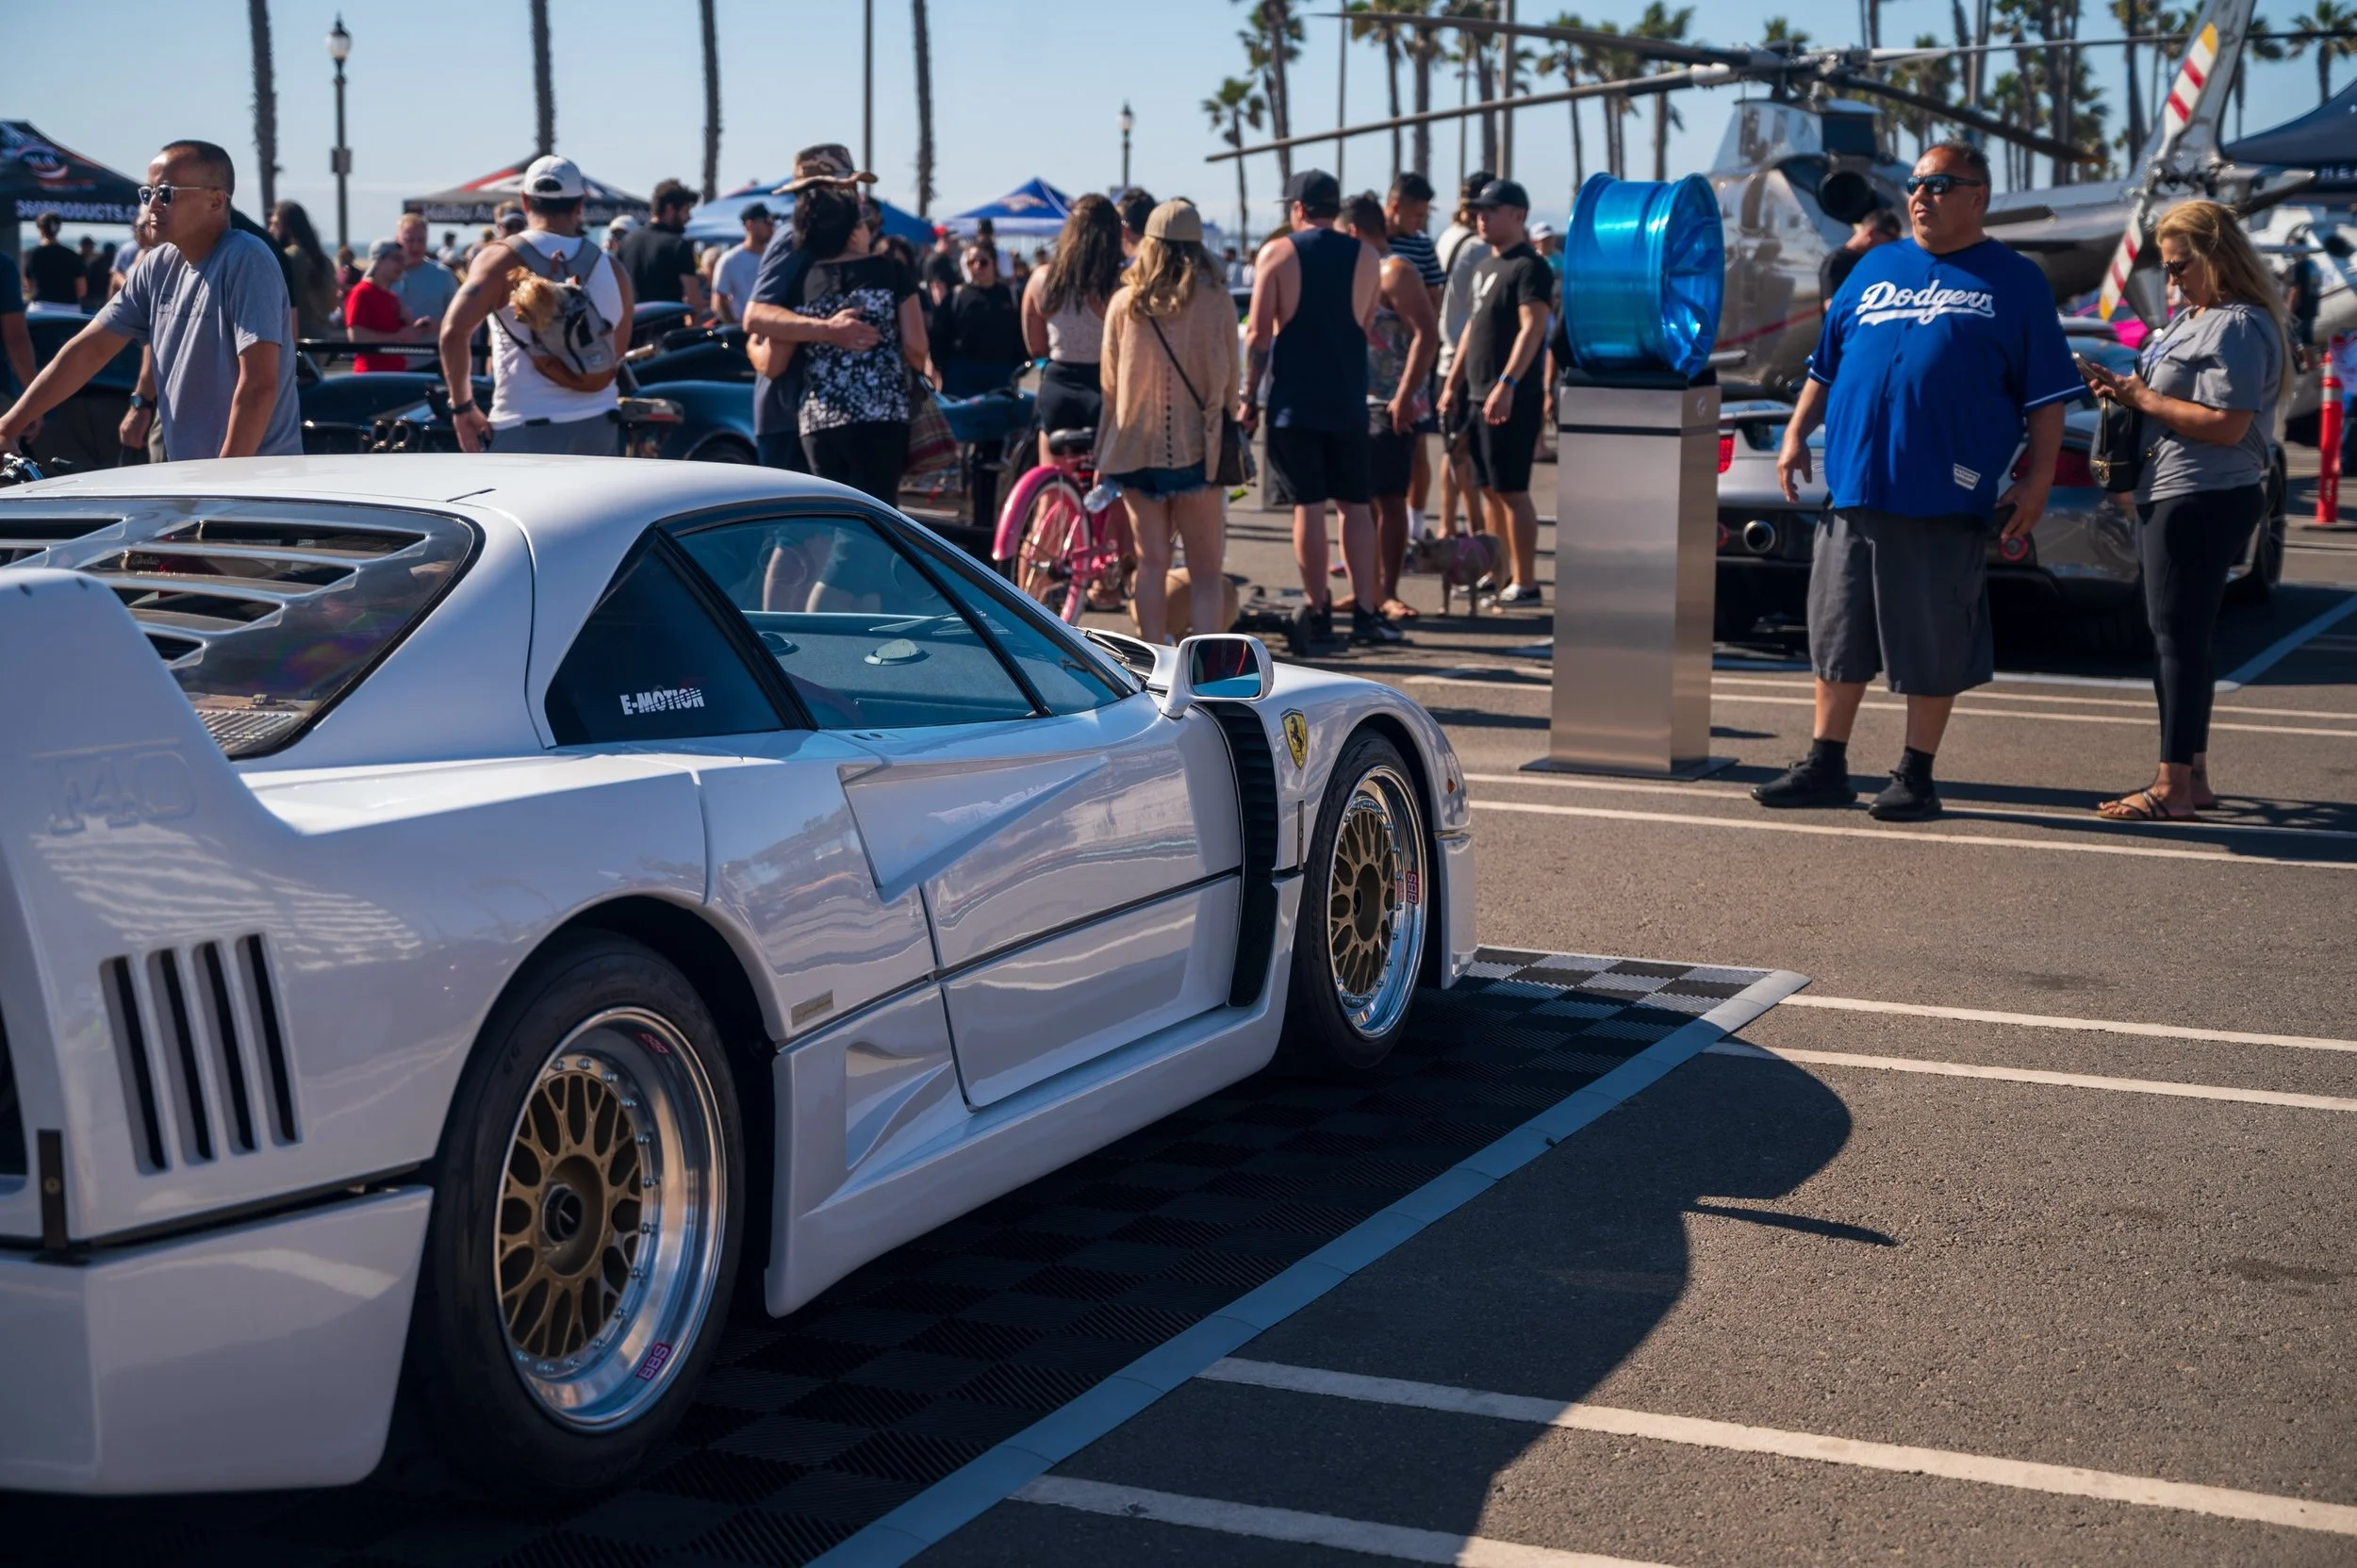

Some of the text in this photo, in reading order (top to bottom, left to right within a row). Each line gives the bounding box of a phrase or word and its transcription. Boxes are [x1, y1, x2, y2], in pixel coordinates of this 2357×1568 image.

[1855, 279, 1995, 326] Dodgers
[619, 687, 705, 716] E-MOTION
[1407, 872, 1418, 904] BBS
[637, 1344, 669, 1380] BBS
